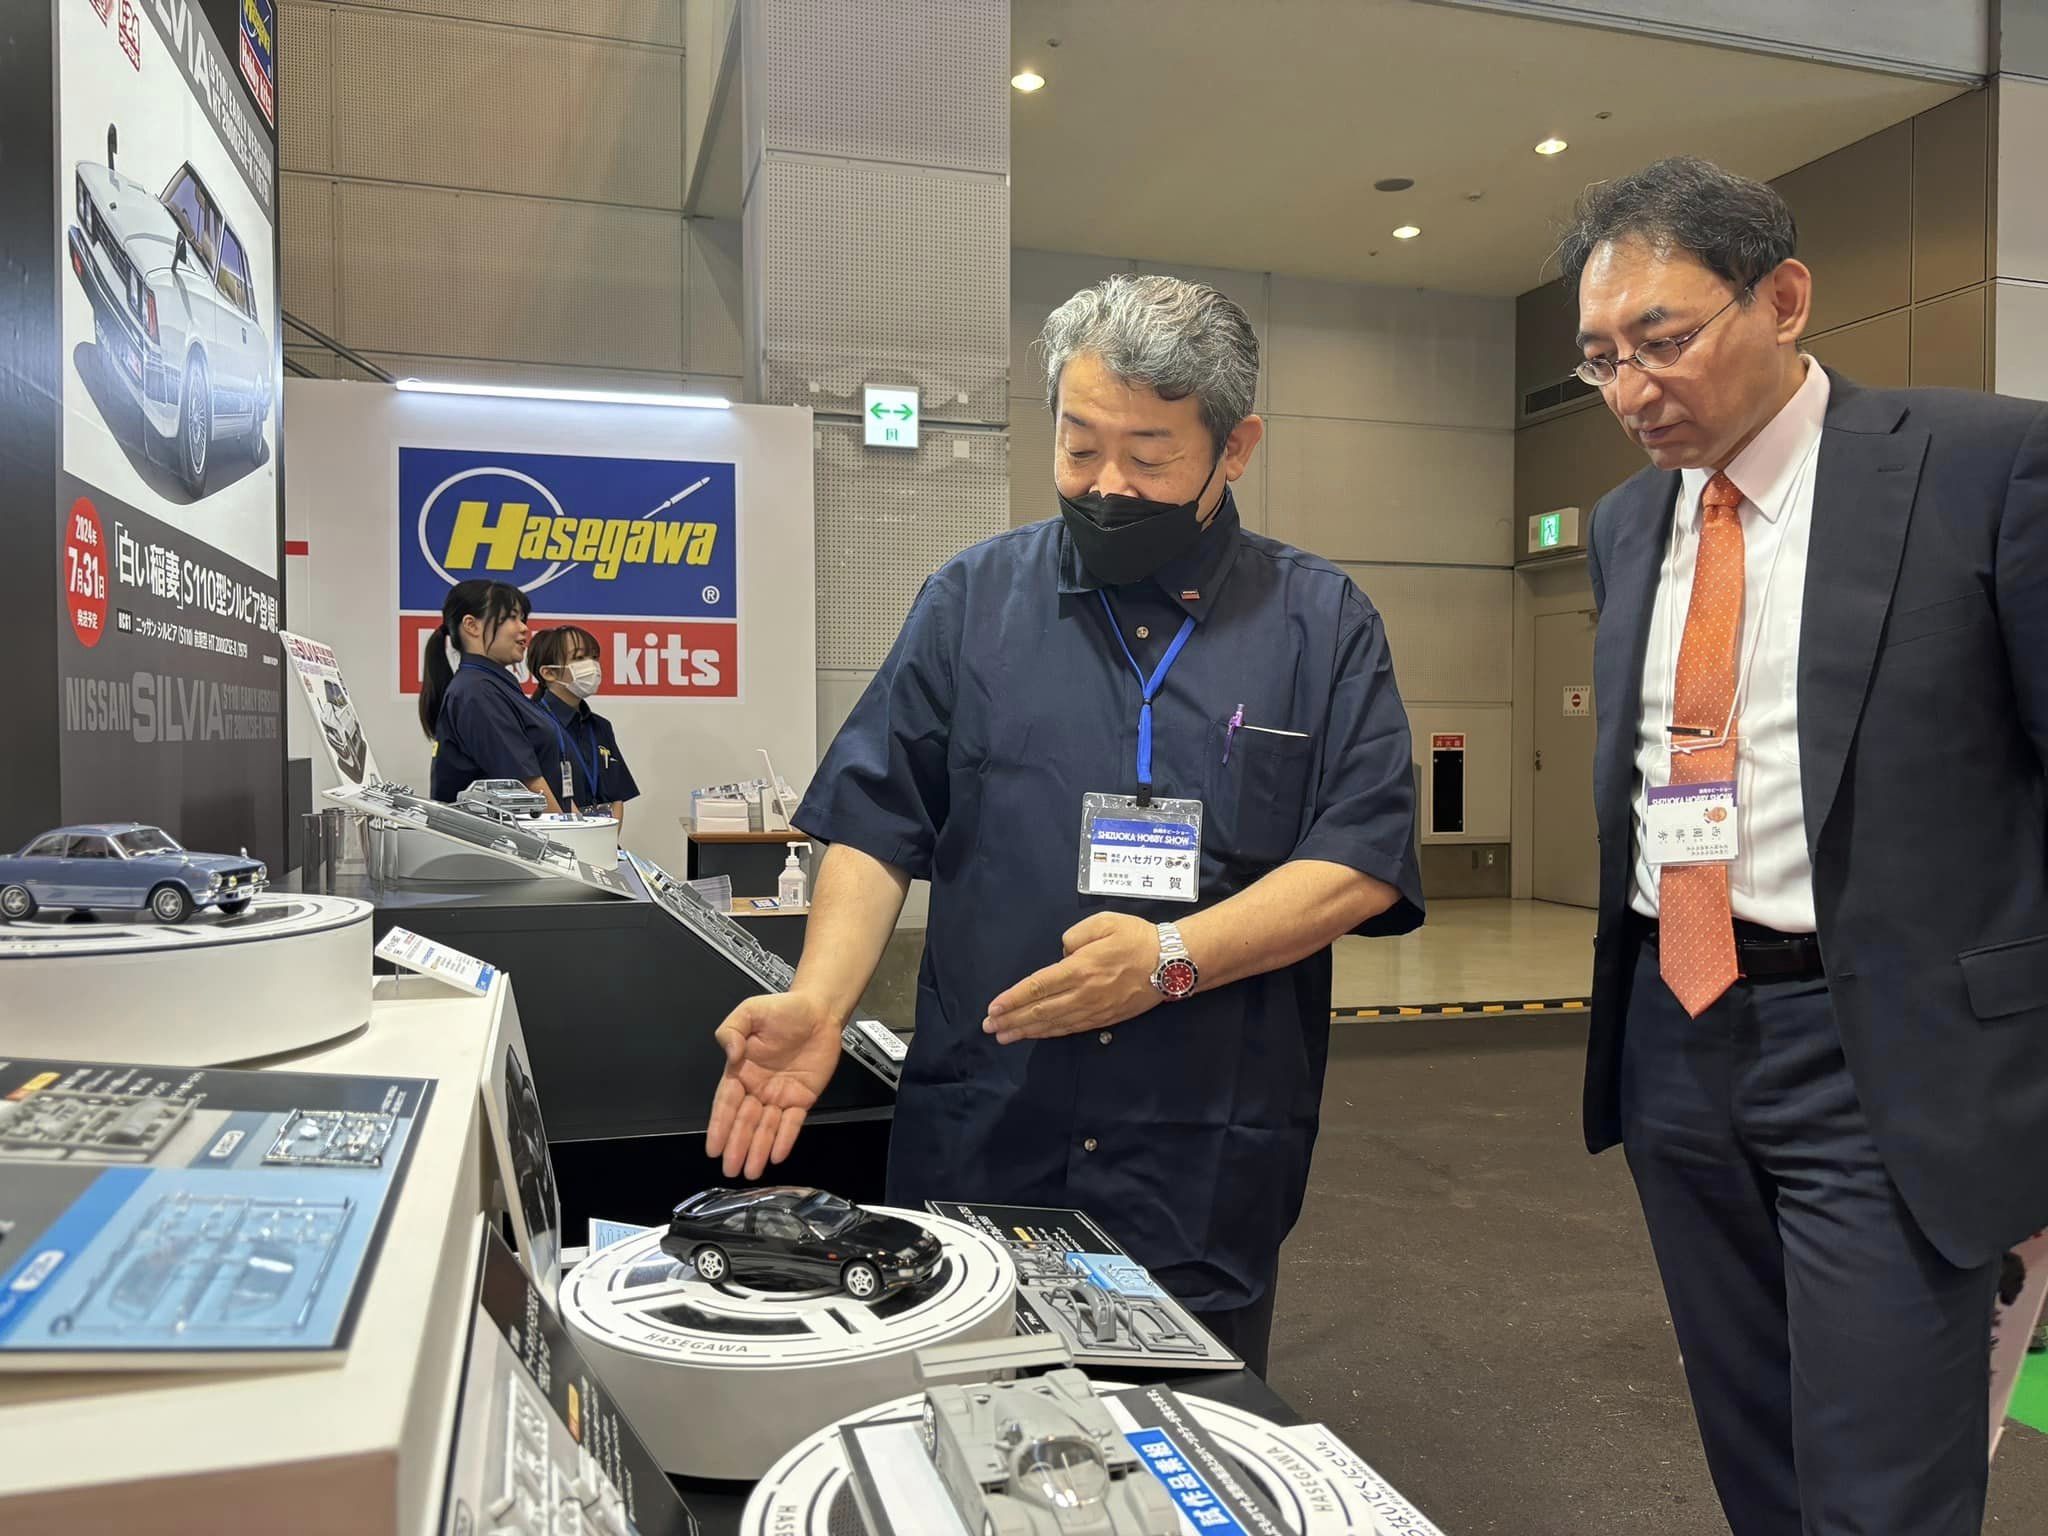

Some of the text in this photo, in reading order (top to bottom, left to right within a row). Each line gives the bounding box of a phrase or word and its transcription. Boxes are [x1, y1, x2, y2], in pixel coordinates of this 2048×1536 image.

[75, 514, 97, 547] 2024年
[444, 501, 718, 580] Hasegawa
[68, 546, 105, 600] 7月31日
[612, 632, 721, 687] kits
[65, 671, 226, 743] NISSAN SILVIA
[1097, 831, 1190, 846] SHIZUOKA HOBBY SHOW
[1122, 855, 1162, 866] ハセガワ
[643, 1332, 748, 1353] HASEGAWA
[1266, 1446, 1334, 1513] HASEGAWA
